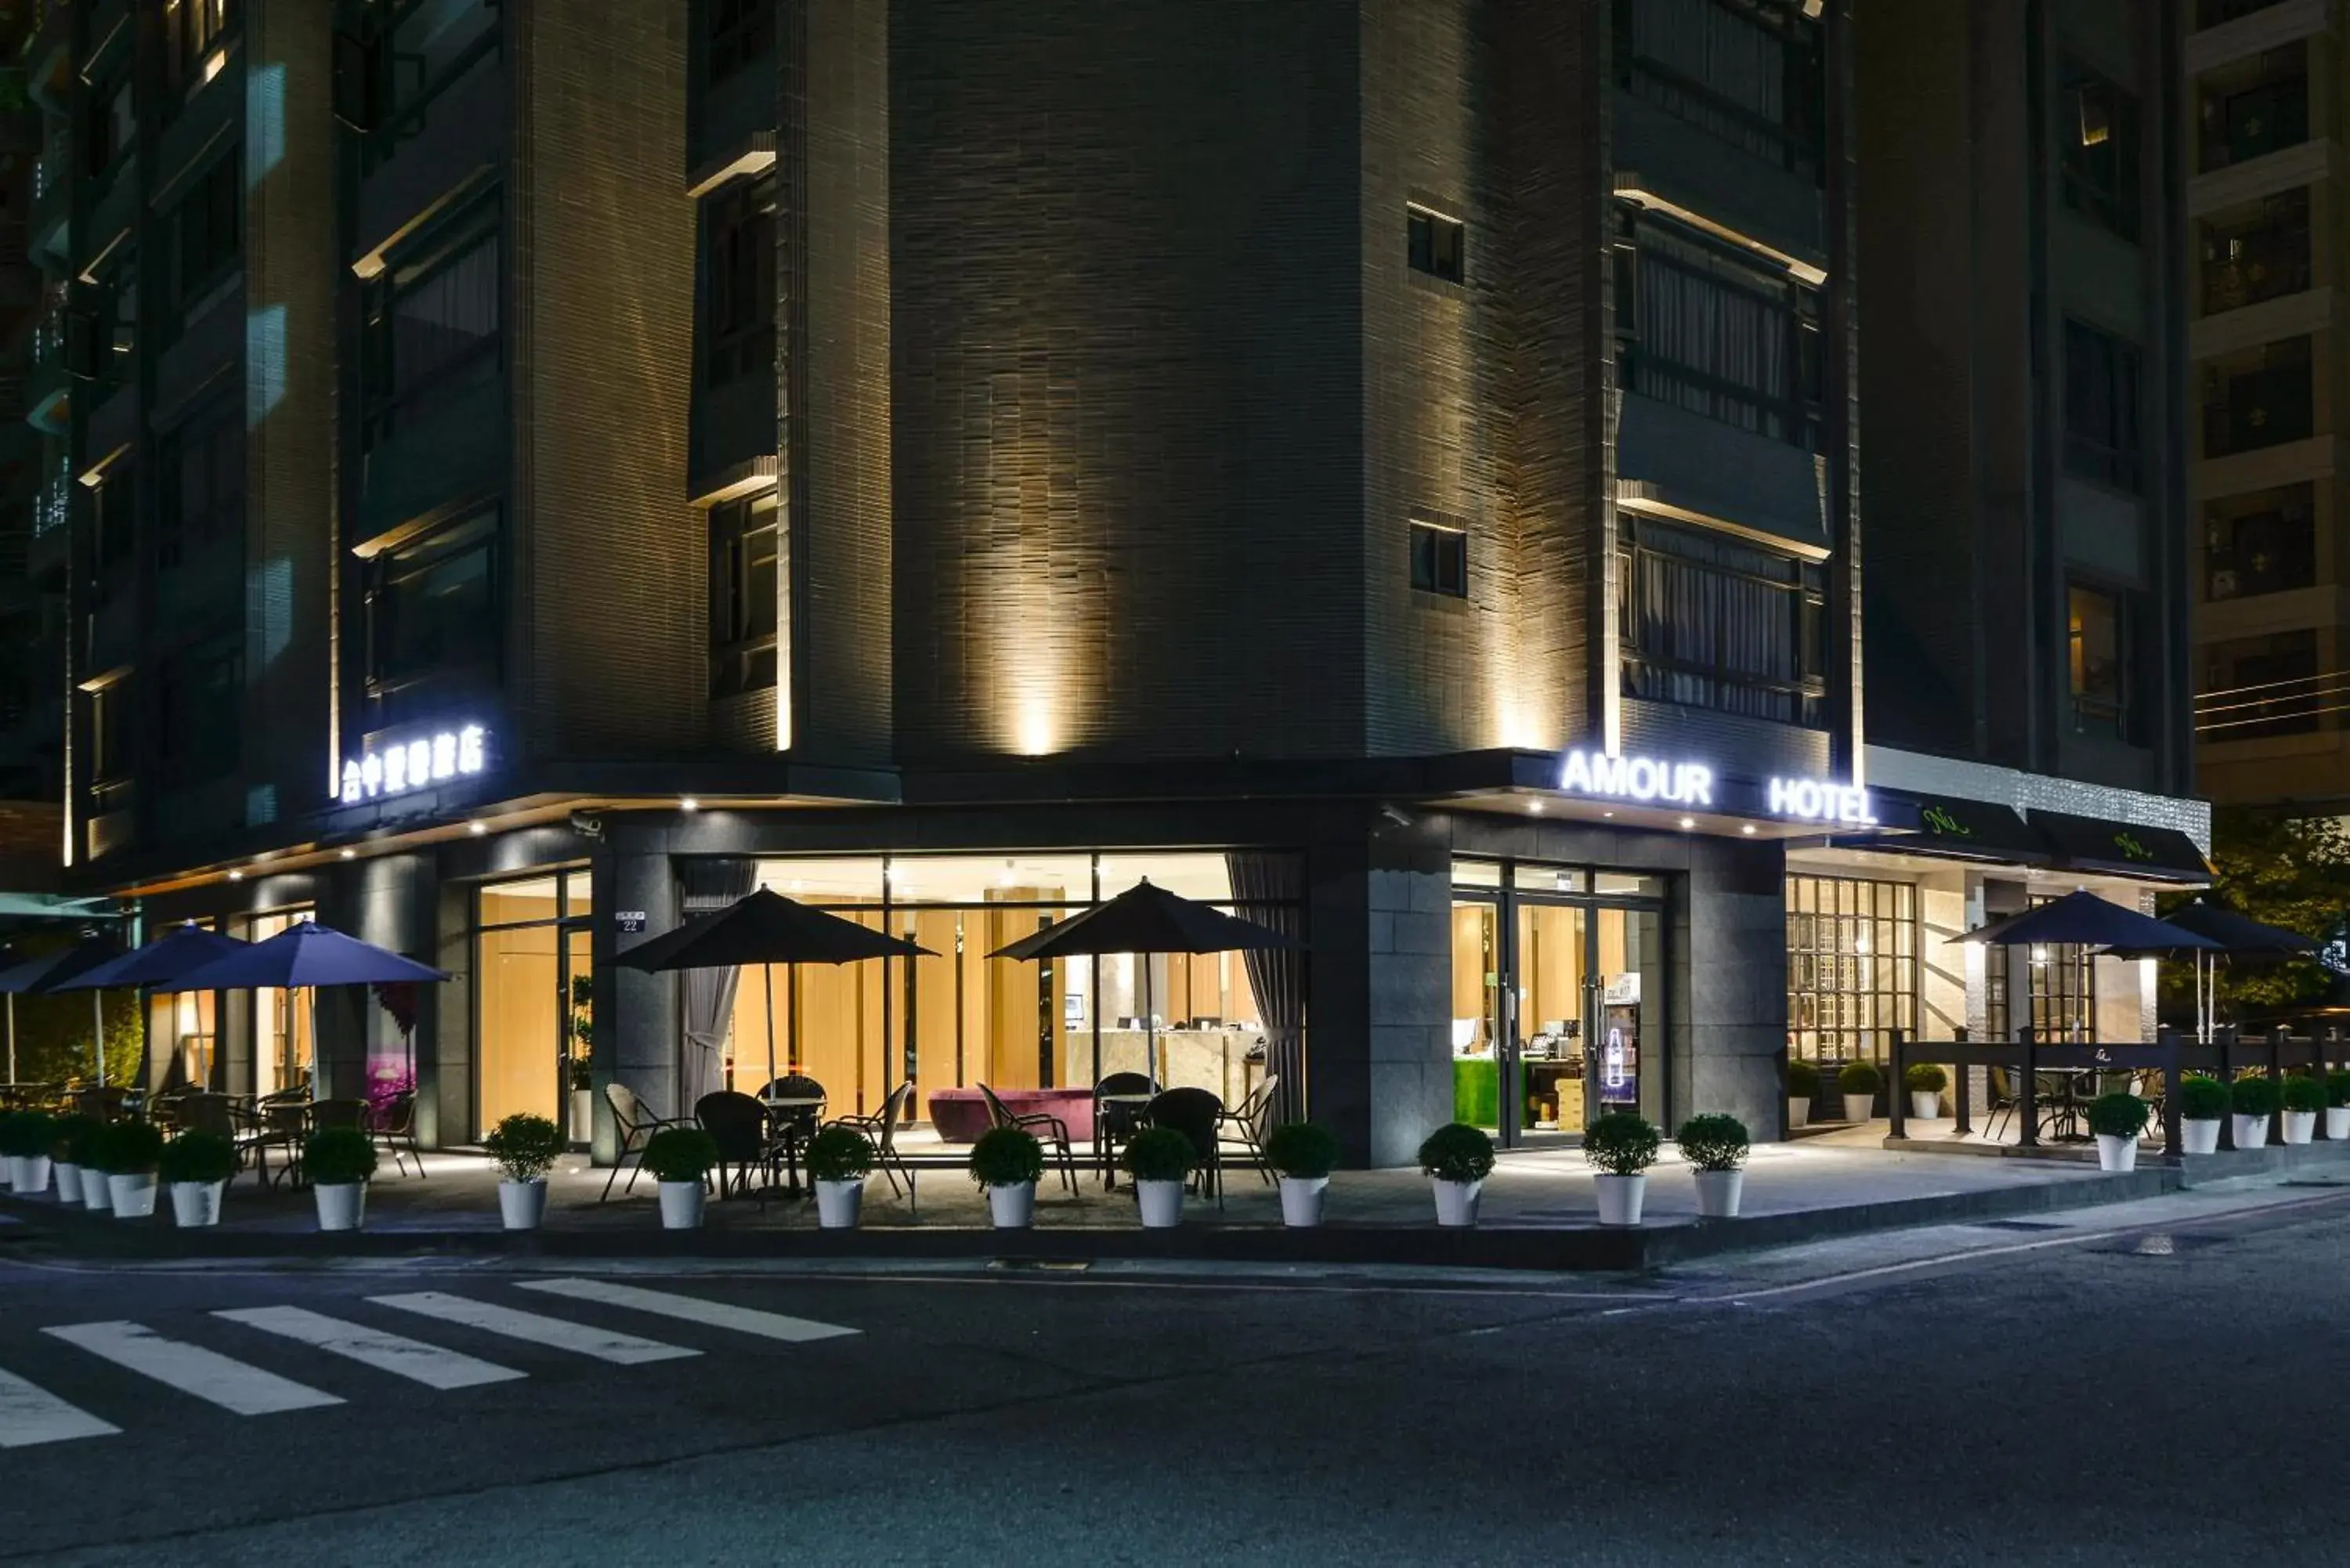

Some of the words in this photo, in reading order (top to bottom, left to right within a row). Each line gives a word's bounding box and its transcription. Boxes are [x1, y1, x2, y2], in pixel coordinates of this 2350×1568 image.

[1561, 750, 1712, 805] AMOUR
[1769, 778, 1878, 825] HOTEL
[624, 920, 637, 931] 22
